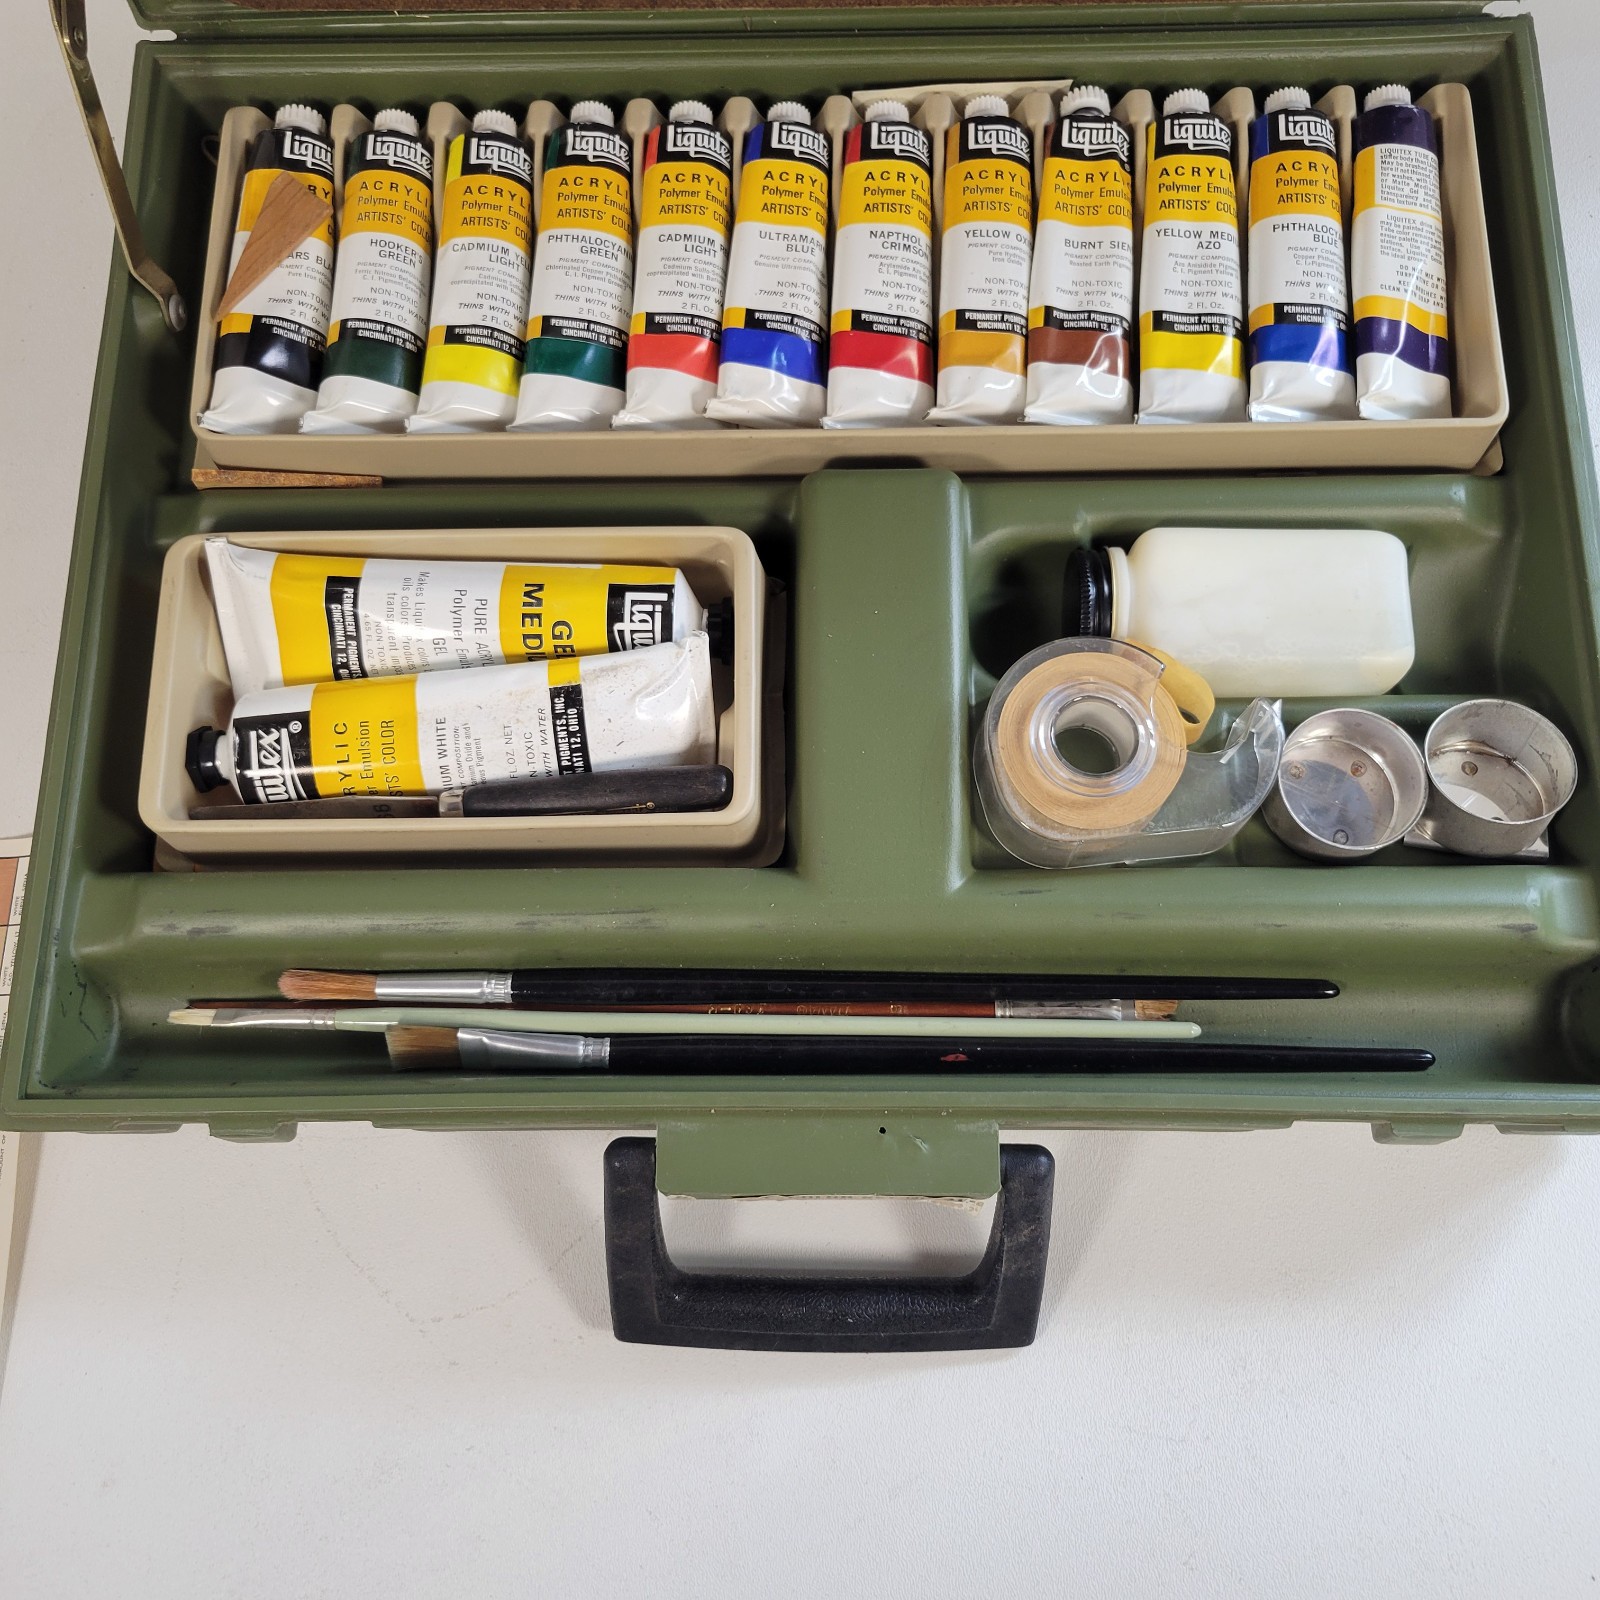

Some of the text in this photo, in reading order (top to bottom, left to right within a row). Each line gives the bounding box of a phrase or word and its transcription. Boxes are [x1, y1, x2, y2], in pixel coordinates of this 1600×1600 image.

[666, 125, 731, 170] Liquite
[870, 122, 930, 167] Liquite
[968, 123, 1029, 163] Liquite
[1062, 118, 1130, 162] Liquitex
[283, 131, 333, 176] Liqui
[366, 134, 433, 180] Liquite
[565, 129, 630, 172] Liquite
[1380, 148, 1412, 156] LIQUITEX
[469, 137, 532, 183] Liquite
[1158, 165, 1232, 183] ACRYLI
[1275, 161, 1336, 180] ACRYL
[661, 173, 728, 197] ACRYLI
[763, 170, 825, 195] ACRYL
[864, 170, 930, 196] ACRYLI
[963, 169, 1030, 191] ACRYLI
[1276, 177, 1319, 188] Polymer
[360, 180, 428, 208] ACRYLI
[559, 177, 628, 199] ACRYLI
[659, 188, 700, 199] Polymer
[762, 185, 804, 198] Polymer
[863, 187, 906, 197] Polymer
[963, 185, 1004, 196] Polymer
[1054, 183, 1094, 199] Polymer
[1158, 182, 1201, 194] Polymer
[358, 195, 398, 206] Polymer
[463, 185, 531, 213] ACRYLI
[558, 192, 599, 203] Polymer
[1159, 199, 1210, 210] ARTISTS'
[1277, 192, 1327, 204] ARTISTS'
[461, 200, 503, 211] Polymer
[659, 204, 708, 215] ARTISTS'
[761, 202, 811, 216] ARTISTS'
[863, 202, 913, 214] ARTISTS'
[964, 200, 1013, 212] ARTISTS'
[1055, 201, 1102, 215] ARTISTS'
[357, 211, 406, 225] ARTISTS'
[557, 207, 606, 220] ARTISTS'
[461, 216, 510, 230] ARTISTS'
[658, 233, 716, 247] CADMIUM
[759, 230, 825, 252] ULTRAMARI
[869, 230, 922, 247] NAPTHOL
[965, 229, 1011, 239] YELLOW
[1156, 228, 1203, 239] YELLOW
[1313, 233, 1339, 249] BLUE
[370, 238, 424, 264] HOOKER'S
[452, 242, 510, 256] CADMIUM
[684, 244, 717, 258] LIGHT
[786, 244, 816, 257] BLUE
[882, 240, 929, 261] CRIMSON
[1064, 238, 1132, 254] BURNT SIEN
[1196, 241, 1222, 250] AZO
[379, 249, 416, 268] GREEN
[580, 245, 619, 262] GREEN
[489, 254, 521, 272] LIGHT
[1071, 280, 1123, 289] NON-TOXIC
[1181, 279, 1233, 288] NON-TOXIC
[1285, 280, 1311, 288] THINS
[370, 286, 419, 308] NON-TOXIC
[573, 284, 622, 302] NON-TOXIC
[688, 293, 711, 302] WITH
[758, 289, 784, 297] THINS
[864, 289, 889, 298] THINS
[1056, 287, 1079, 296] THINS
[1164, 288, 1189, 297] THINS
[298, 300, 319, 313] WITH
[477, 292, 523, 314] NON-TOXIC
[655, 315, 692, 325] PERMANENT
[755, 312, 792, 324] PERMANENT
[965, 312, 1002, 321] PERMANENT
[1053, 310, 1088, 320] PERMANENT
[1162, 313, 1199, 322] PERMANENT
[262, 317, 299, 332] PERMANENT
[347, 320, 385, 332] PERMANENT
[551, 319, 588, 330] PERMANENT
[1064, 321, 1099, 329] CINCINNATI
[1173, 323, 1210, 333] CINCINNATI
[357, 329, 395, 343] CINCINNATI
[455, 328, 492, 340] PERMANENT
[562, 328, 598, 341] CINCINNATI
[415, 571, 430, 597] Makes
[342, 587, 356, 638] PERMANENT
[331, 603, 347, 649] CINCINNATI
[402, 577, 417, 671] oils Produces
[450, 589, 475, 670] Polymer Emuls
[613, 592, 669, 653] Liqu
[474, 598, 496, 668] PURE ACRYL
[374, 621, 389, 671] NON-TOXIC
[432, 637, 448, 657] GEL
[567, 707, 578, 731] OHIO
[554, 693, 573, 767] PIGMENTS, INC.
[381, 719, 397, 765] COLOR
[435, 716, 448, 760] WHITE
[538, 707, 553, 778] WITH WATER
[570, 733, 582, 747] 12,
[357, 720, 375, 780] Emulsion
[465, 737, 474, 763] Oxide
[475, 737, 484, 768] Pigment
[524, 731, 538, 778] N-TOXIC
[334, 721, 358, 797] RYLIC
